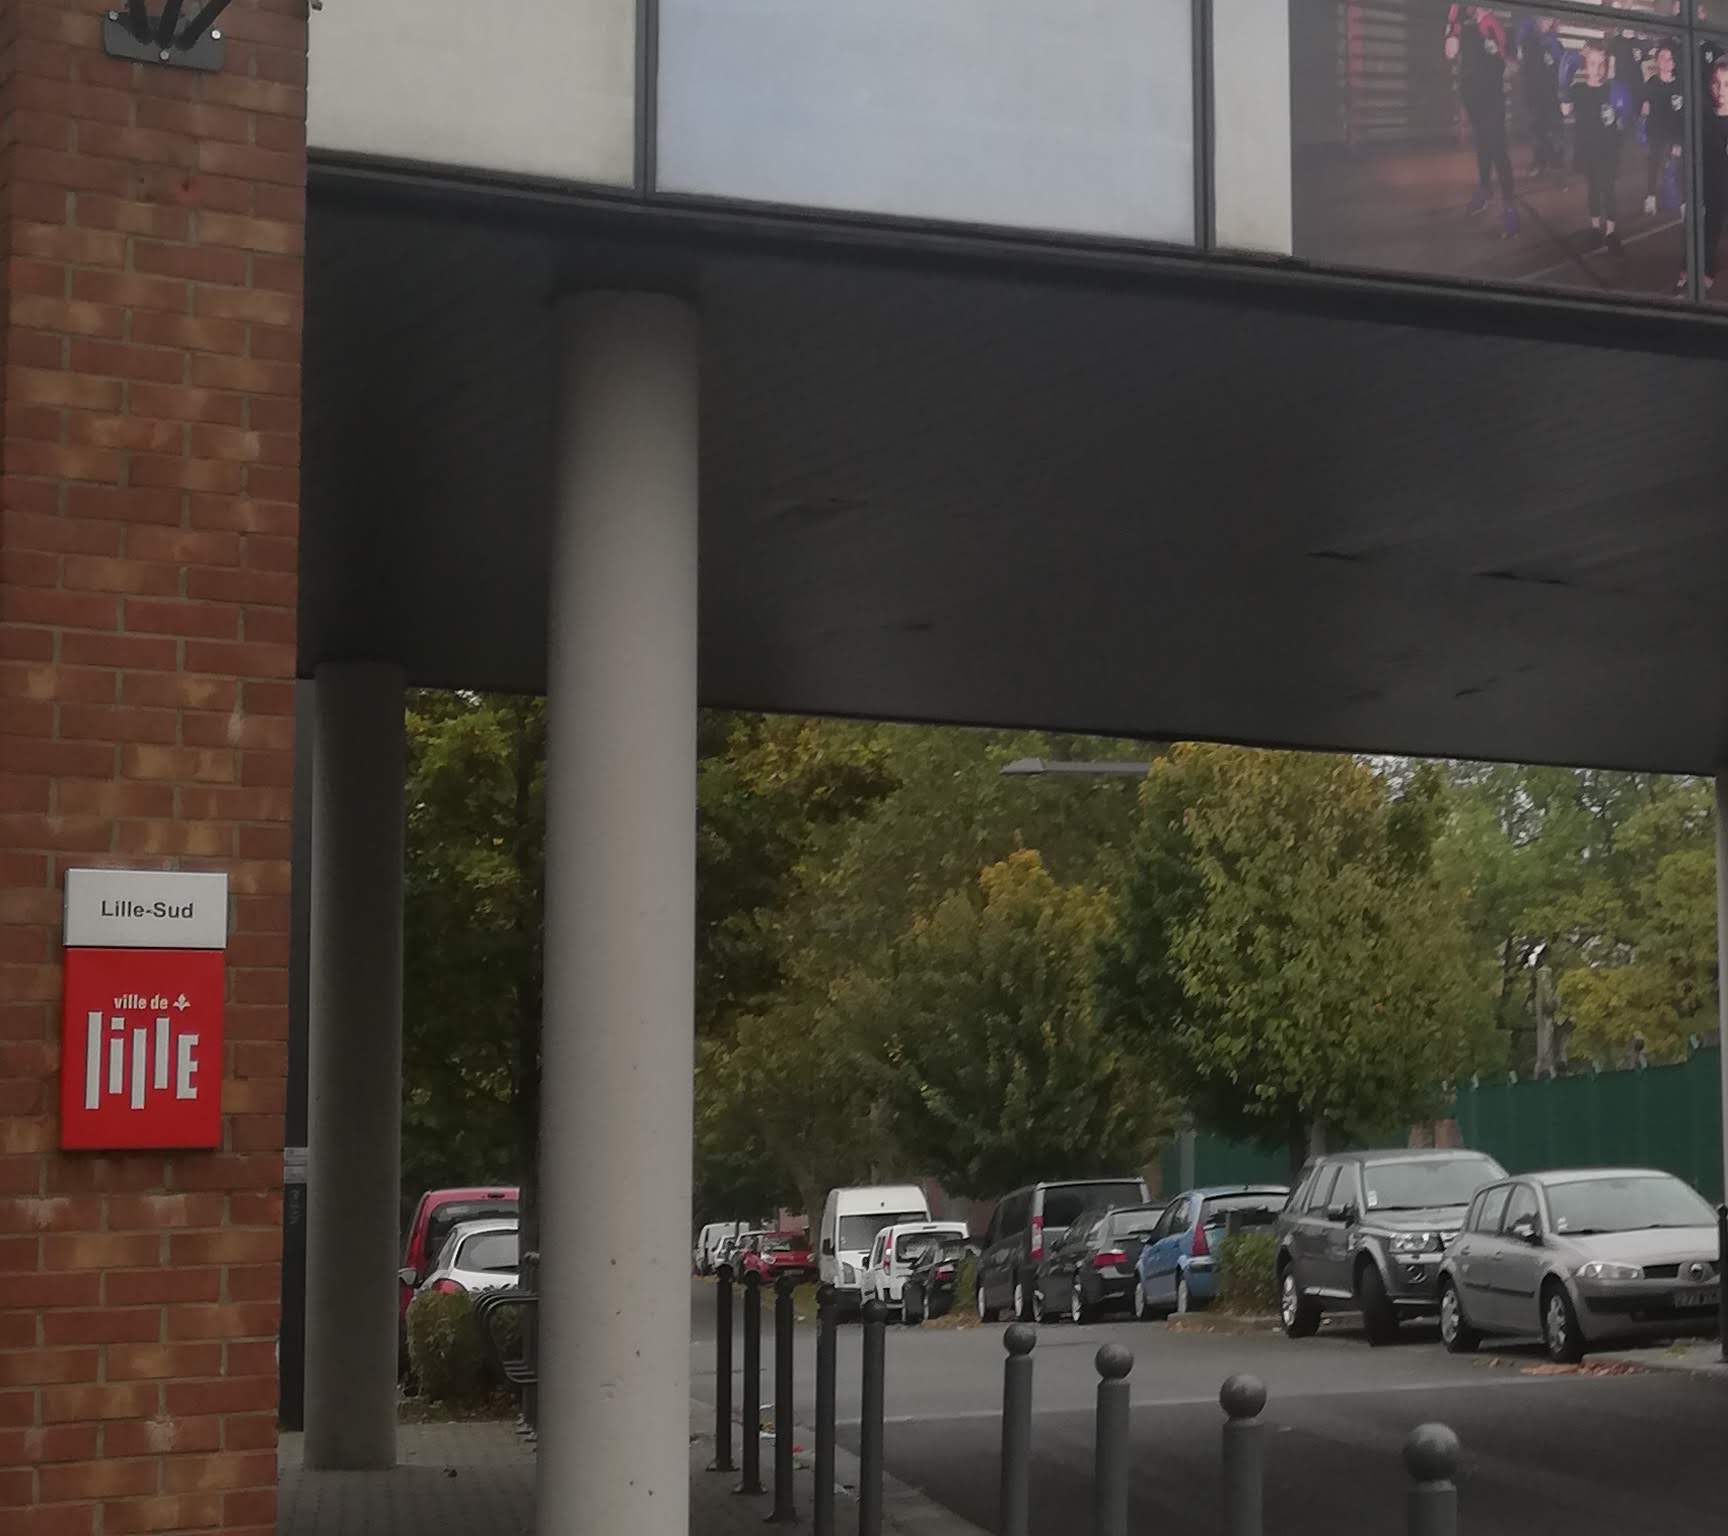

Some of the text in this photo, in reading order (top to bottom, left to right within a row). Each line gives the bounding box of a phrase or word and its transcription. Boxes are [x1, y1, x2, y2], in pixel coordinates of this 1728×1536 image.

[101, 900, 194, 919] Lille-Sud
[113, 994, 168, 1010] ville de
